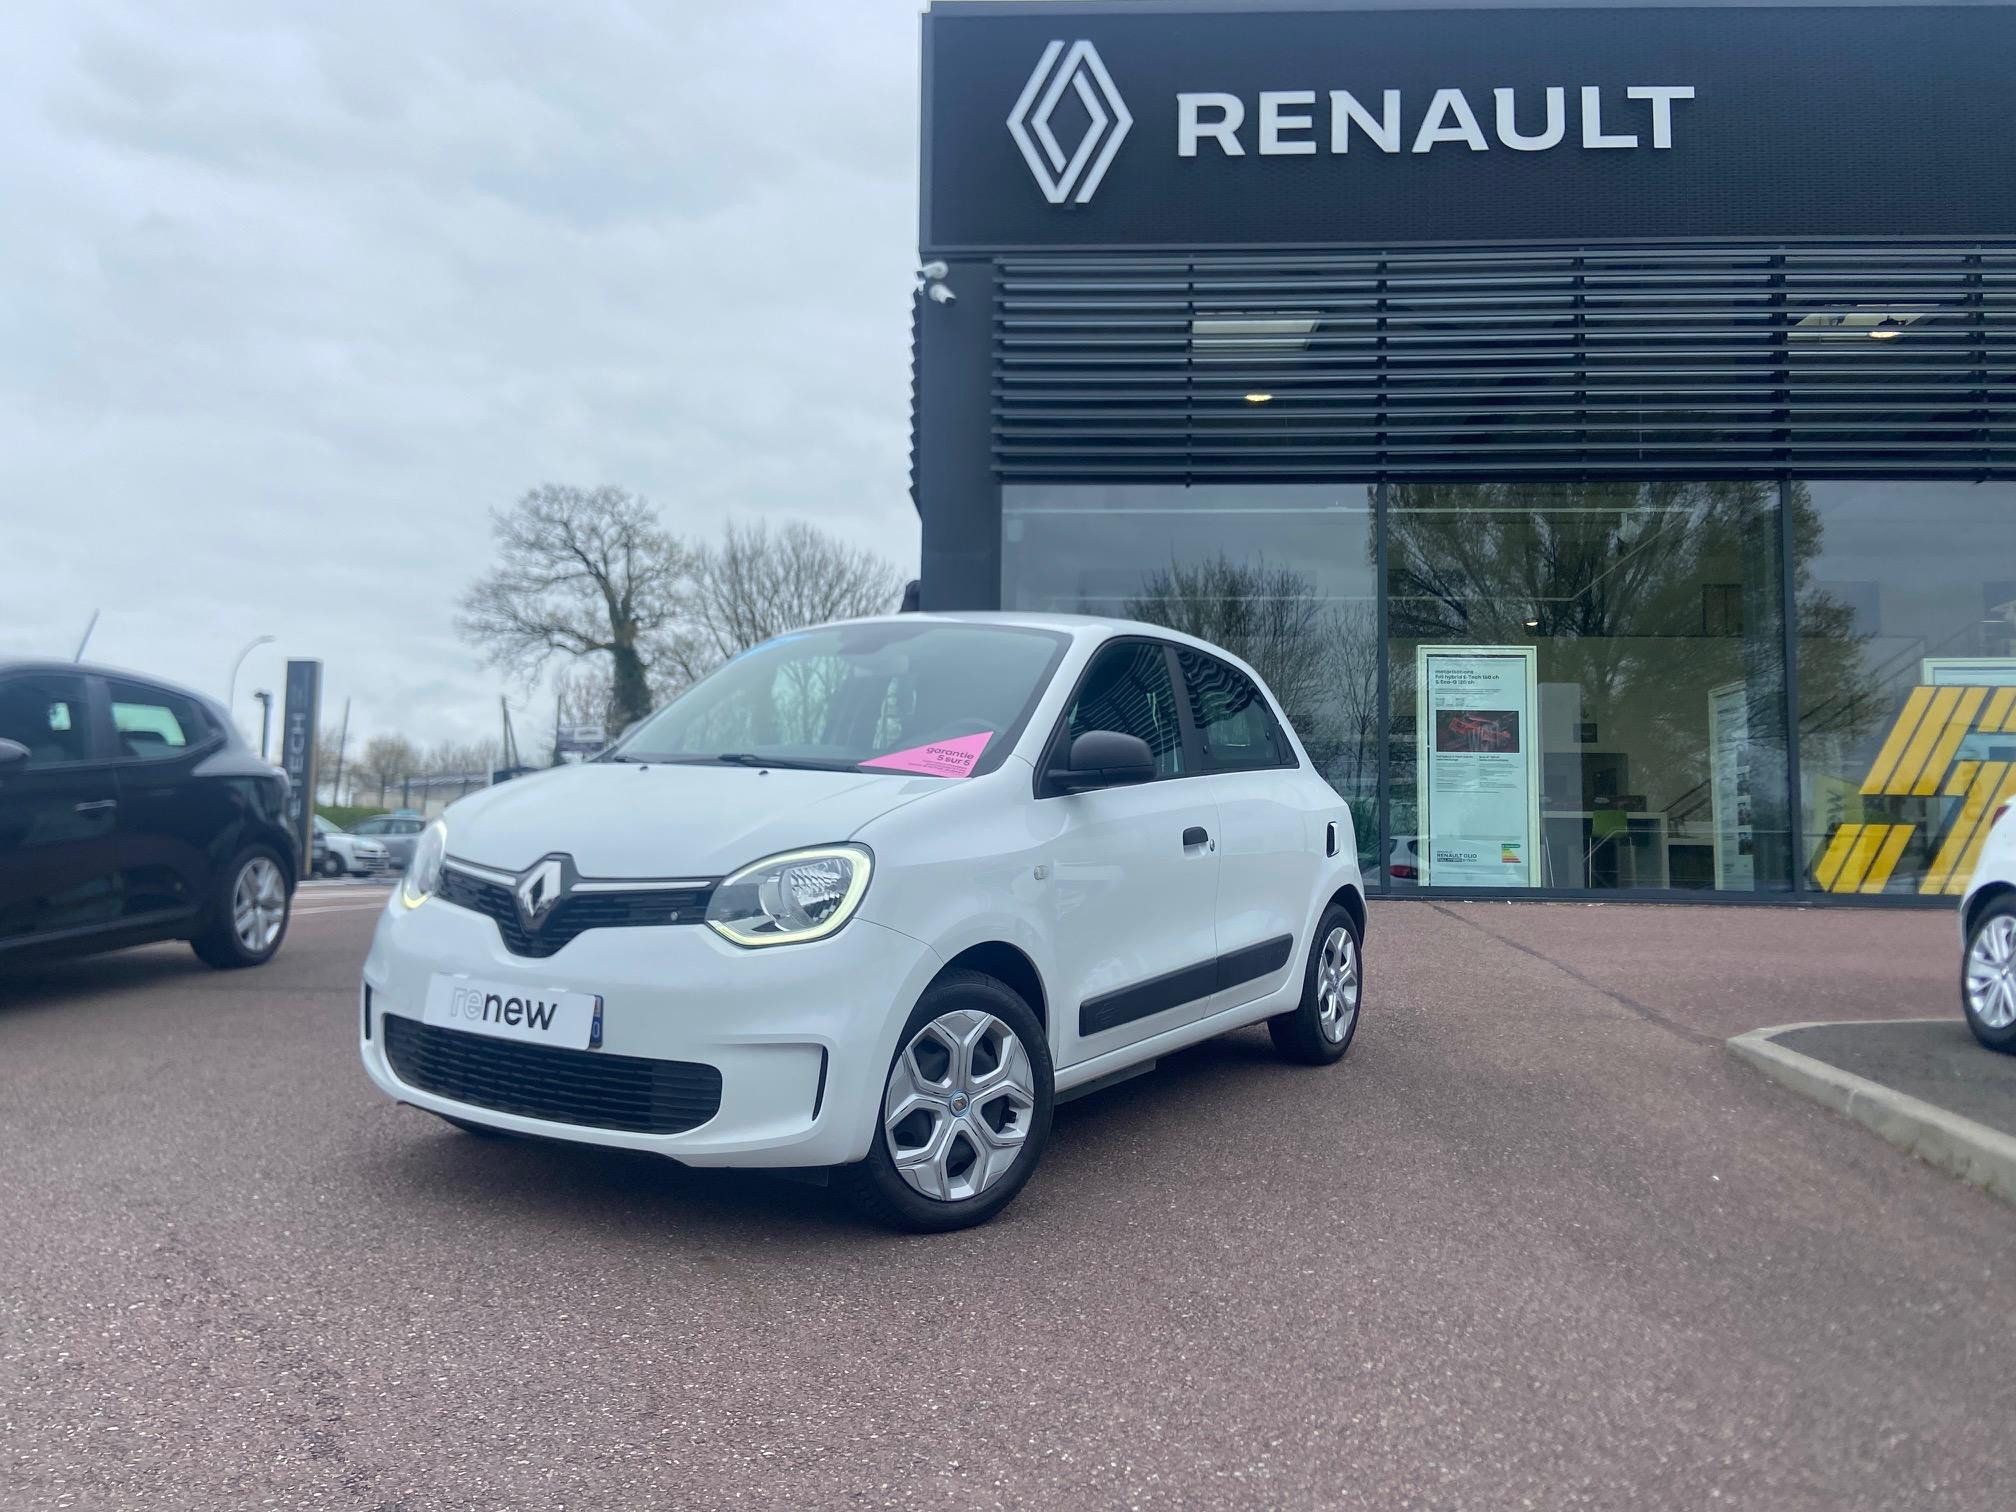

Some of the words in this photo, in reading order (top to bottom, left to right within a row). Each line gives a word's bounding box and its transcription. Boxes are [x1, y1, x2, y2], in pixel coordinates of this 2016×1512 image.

[1177, 85, 1695, 157] RENAULT
[926, 747, 974, 759] garantie
[450, 987, 558, 1031] renew
